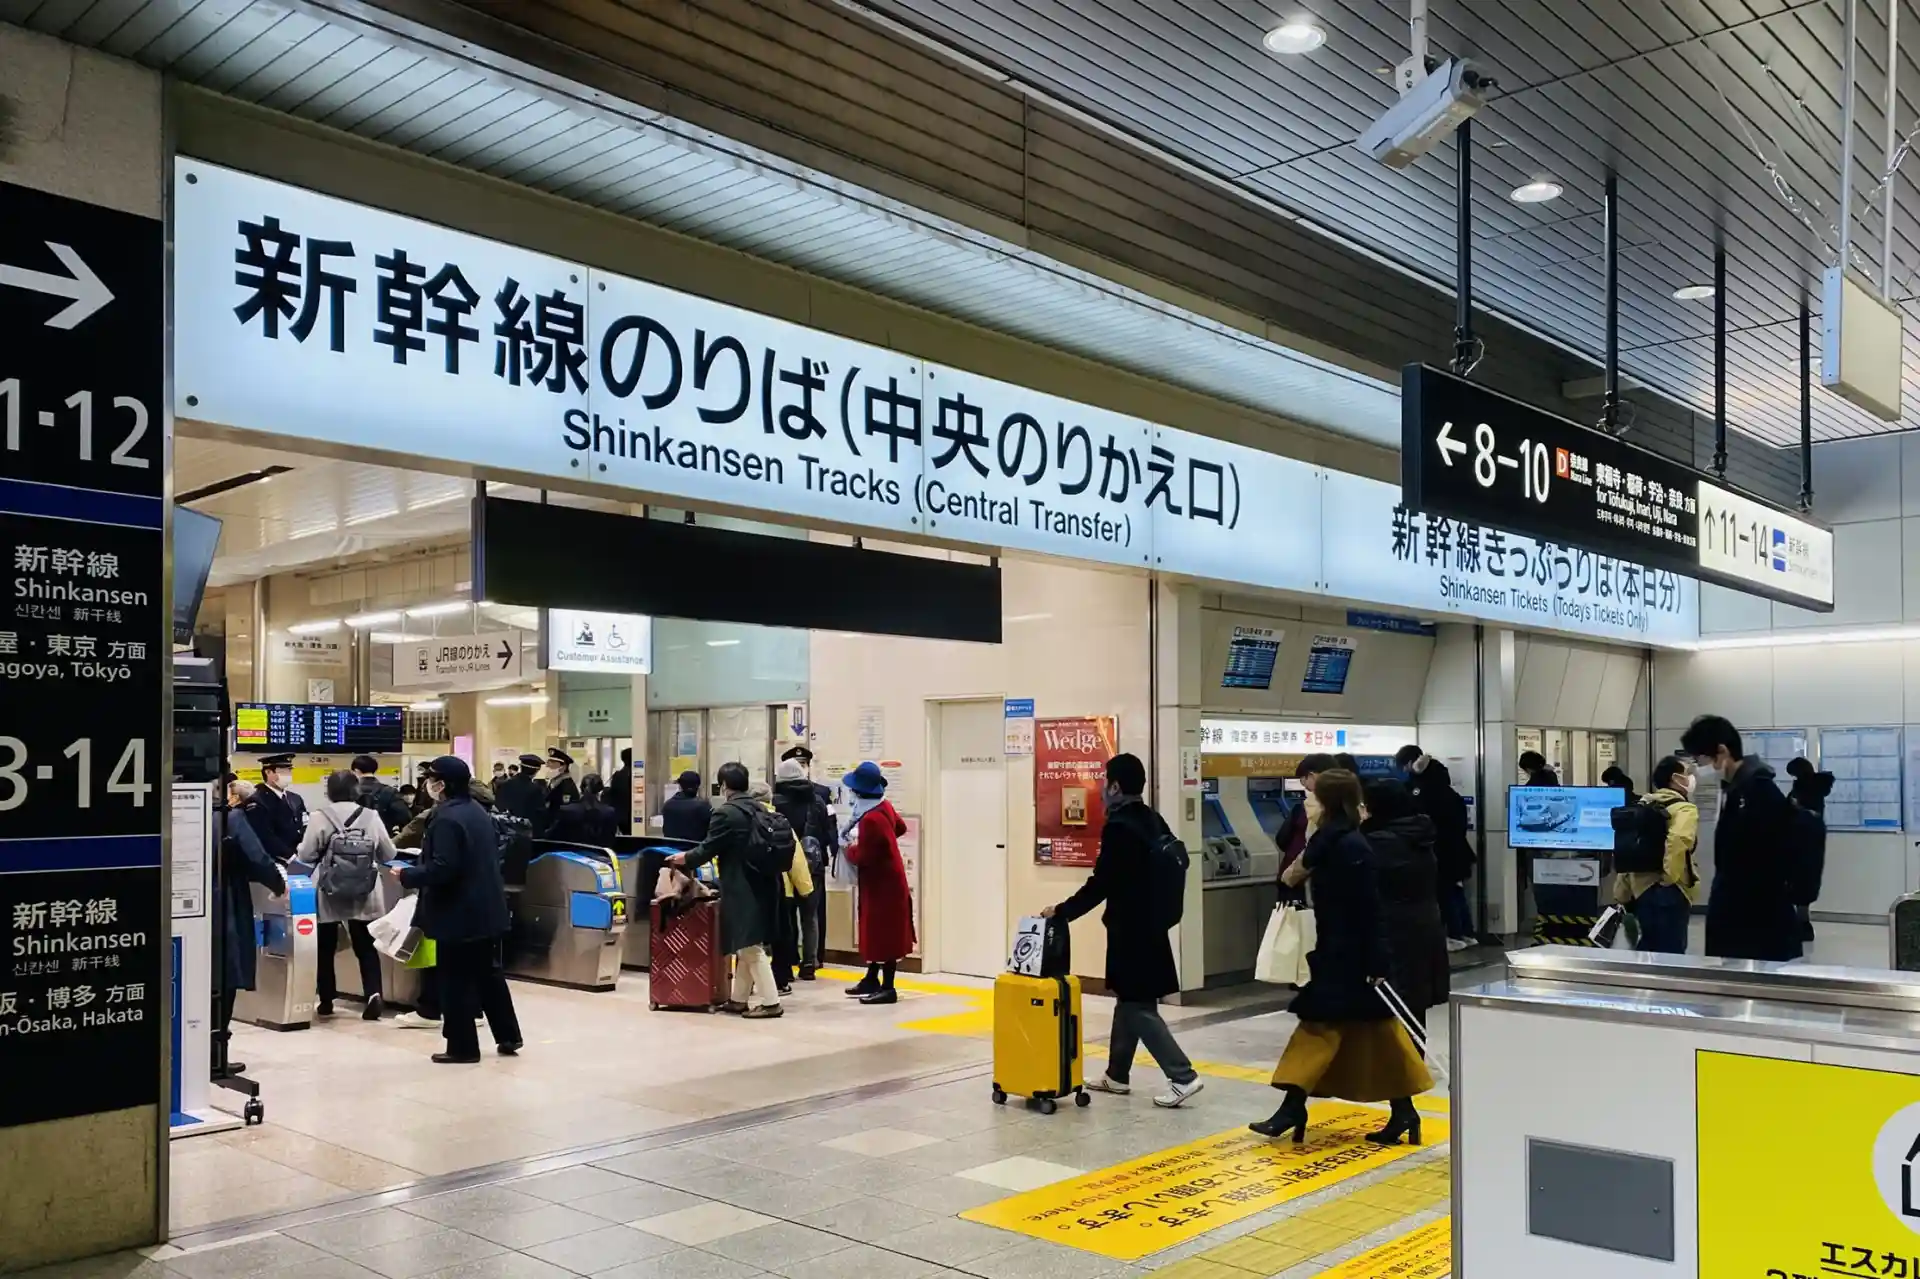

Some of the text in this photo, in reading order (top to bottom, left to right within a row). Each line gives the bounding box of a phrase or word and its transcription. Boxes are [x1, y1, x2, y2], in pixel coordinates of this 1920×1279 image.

[234, 215, 1240, 529] 新幹線のりば(中央のりかえ口)
[1558, 451, 1567, 473] D
[563, 408, 1132, 547] Shinkansen Tracks (Central Transfer)
[1582, 473, 1593, 486] Line
[1596, 485, 1607, 504] for
[1636, 500, 1652, 520] Inari,
[1652, 504, 1663, 525] Uji,
[1663, 507, 1678, 526] Nara
[14, 544, 119, 579] 新幹線
[1391, 502, 1682, 615] 新幹線きっぷうりば(本日分)
[14, 577, 149, 606] Shinkansen
[15, 603, 62, 620] 신칸센
[1440, 574, 1649, 633] Shinkansen Tickets (Today's Tickets Only)
[73, 606, 123, 624] 新干线
[107, 640, 147, 660] 方面
[436, 644, 491, 663] JR線のりかえ
[557, 650, 645, 665] Customer Assistance
[70, 661, 132, 682] Tōkyō
[1043, 728, 1102, 754] Wedge
[1303, 730, 1334, 746] 本日分
[13, 897, 118, 930] 新幹線
[13, 932, 146, 957] Shinkansen
[12, 959, 60, 976] 신칸센
[72, 954, 121, 971] 新干线
[106, 982, 146, 1003] 方面
[83, 1008, 143, 1027] Hakata
[1021, 1206, 1077, 1221] here.
[1820, 1241, 1920, 1279] エスカ
